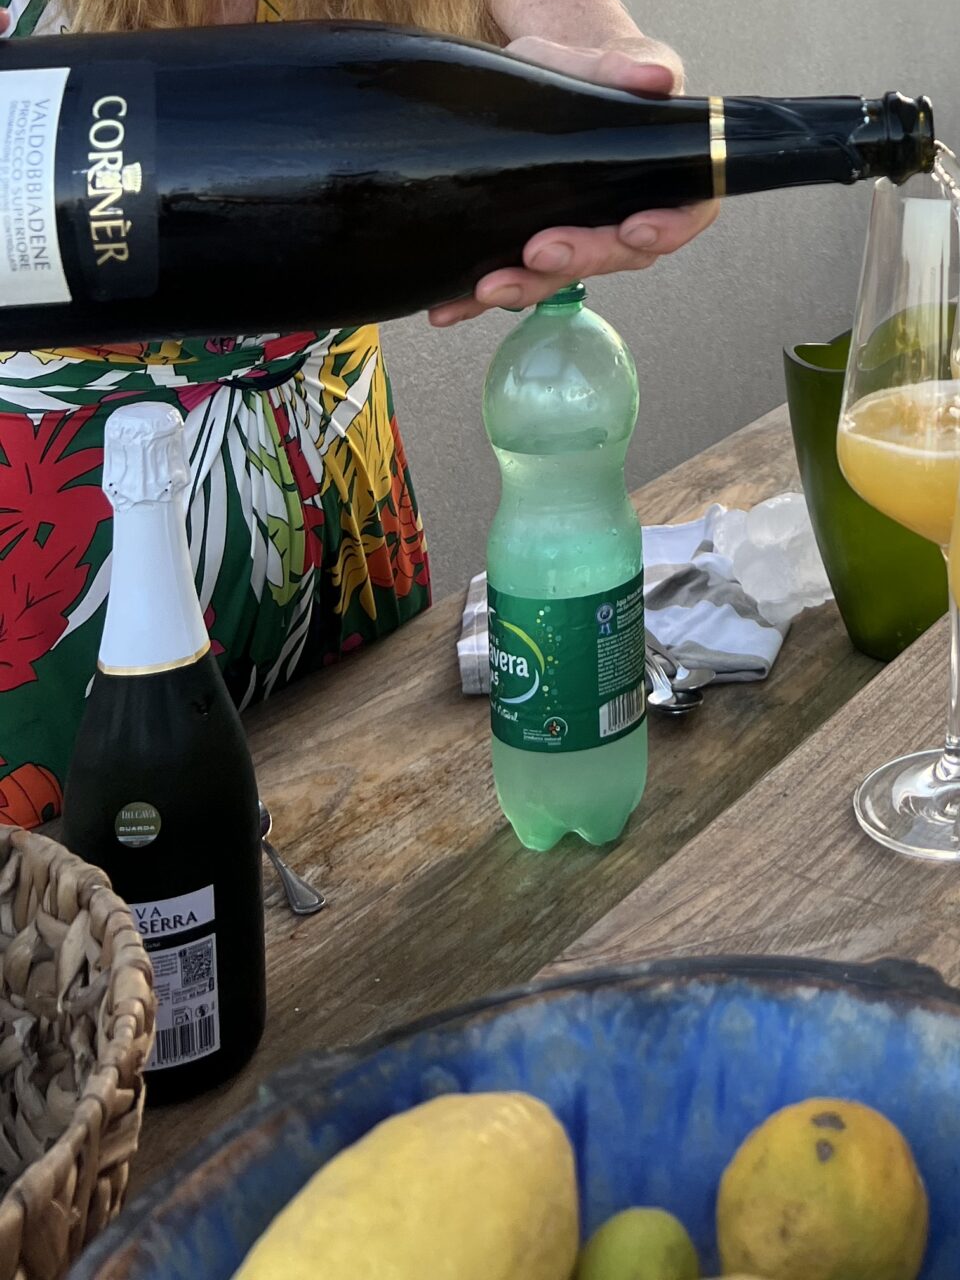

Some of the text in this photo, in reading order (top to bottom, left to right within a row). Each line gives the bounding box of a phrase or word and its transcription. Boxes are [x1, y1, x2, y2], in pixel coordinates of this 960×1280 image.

[10, 100, 31, 270] PROSECCO SUPERIORE
[26, 98, 51, 271] VALDOBBIADENE
[138, 910, 198, 935] SERRA
